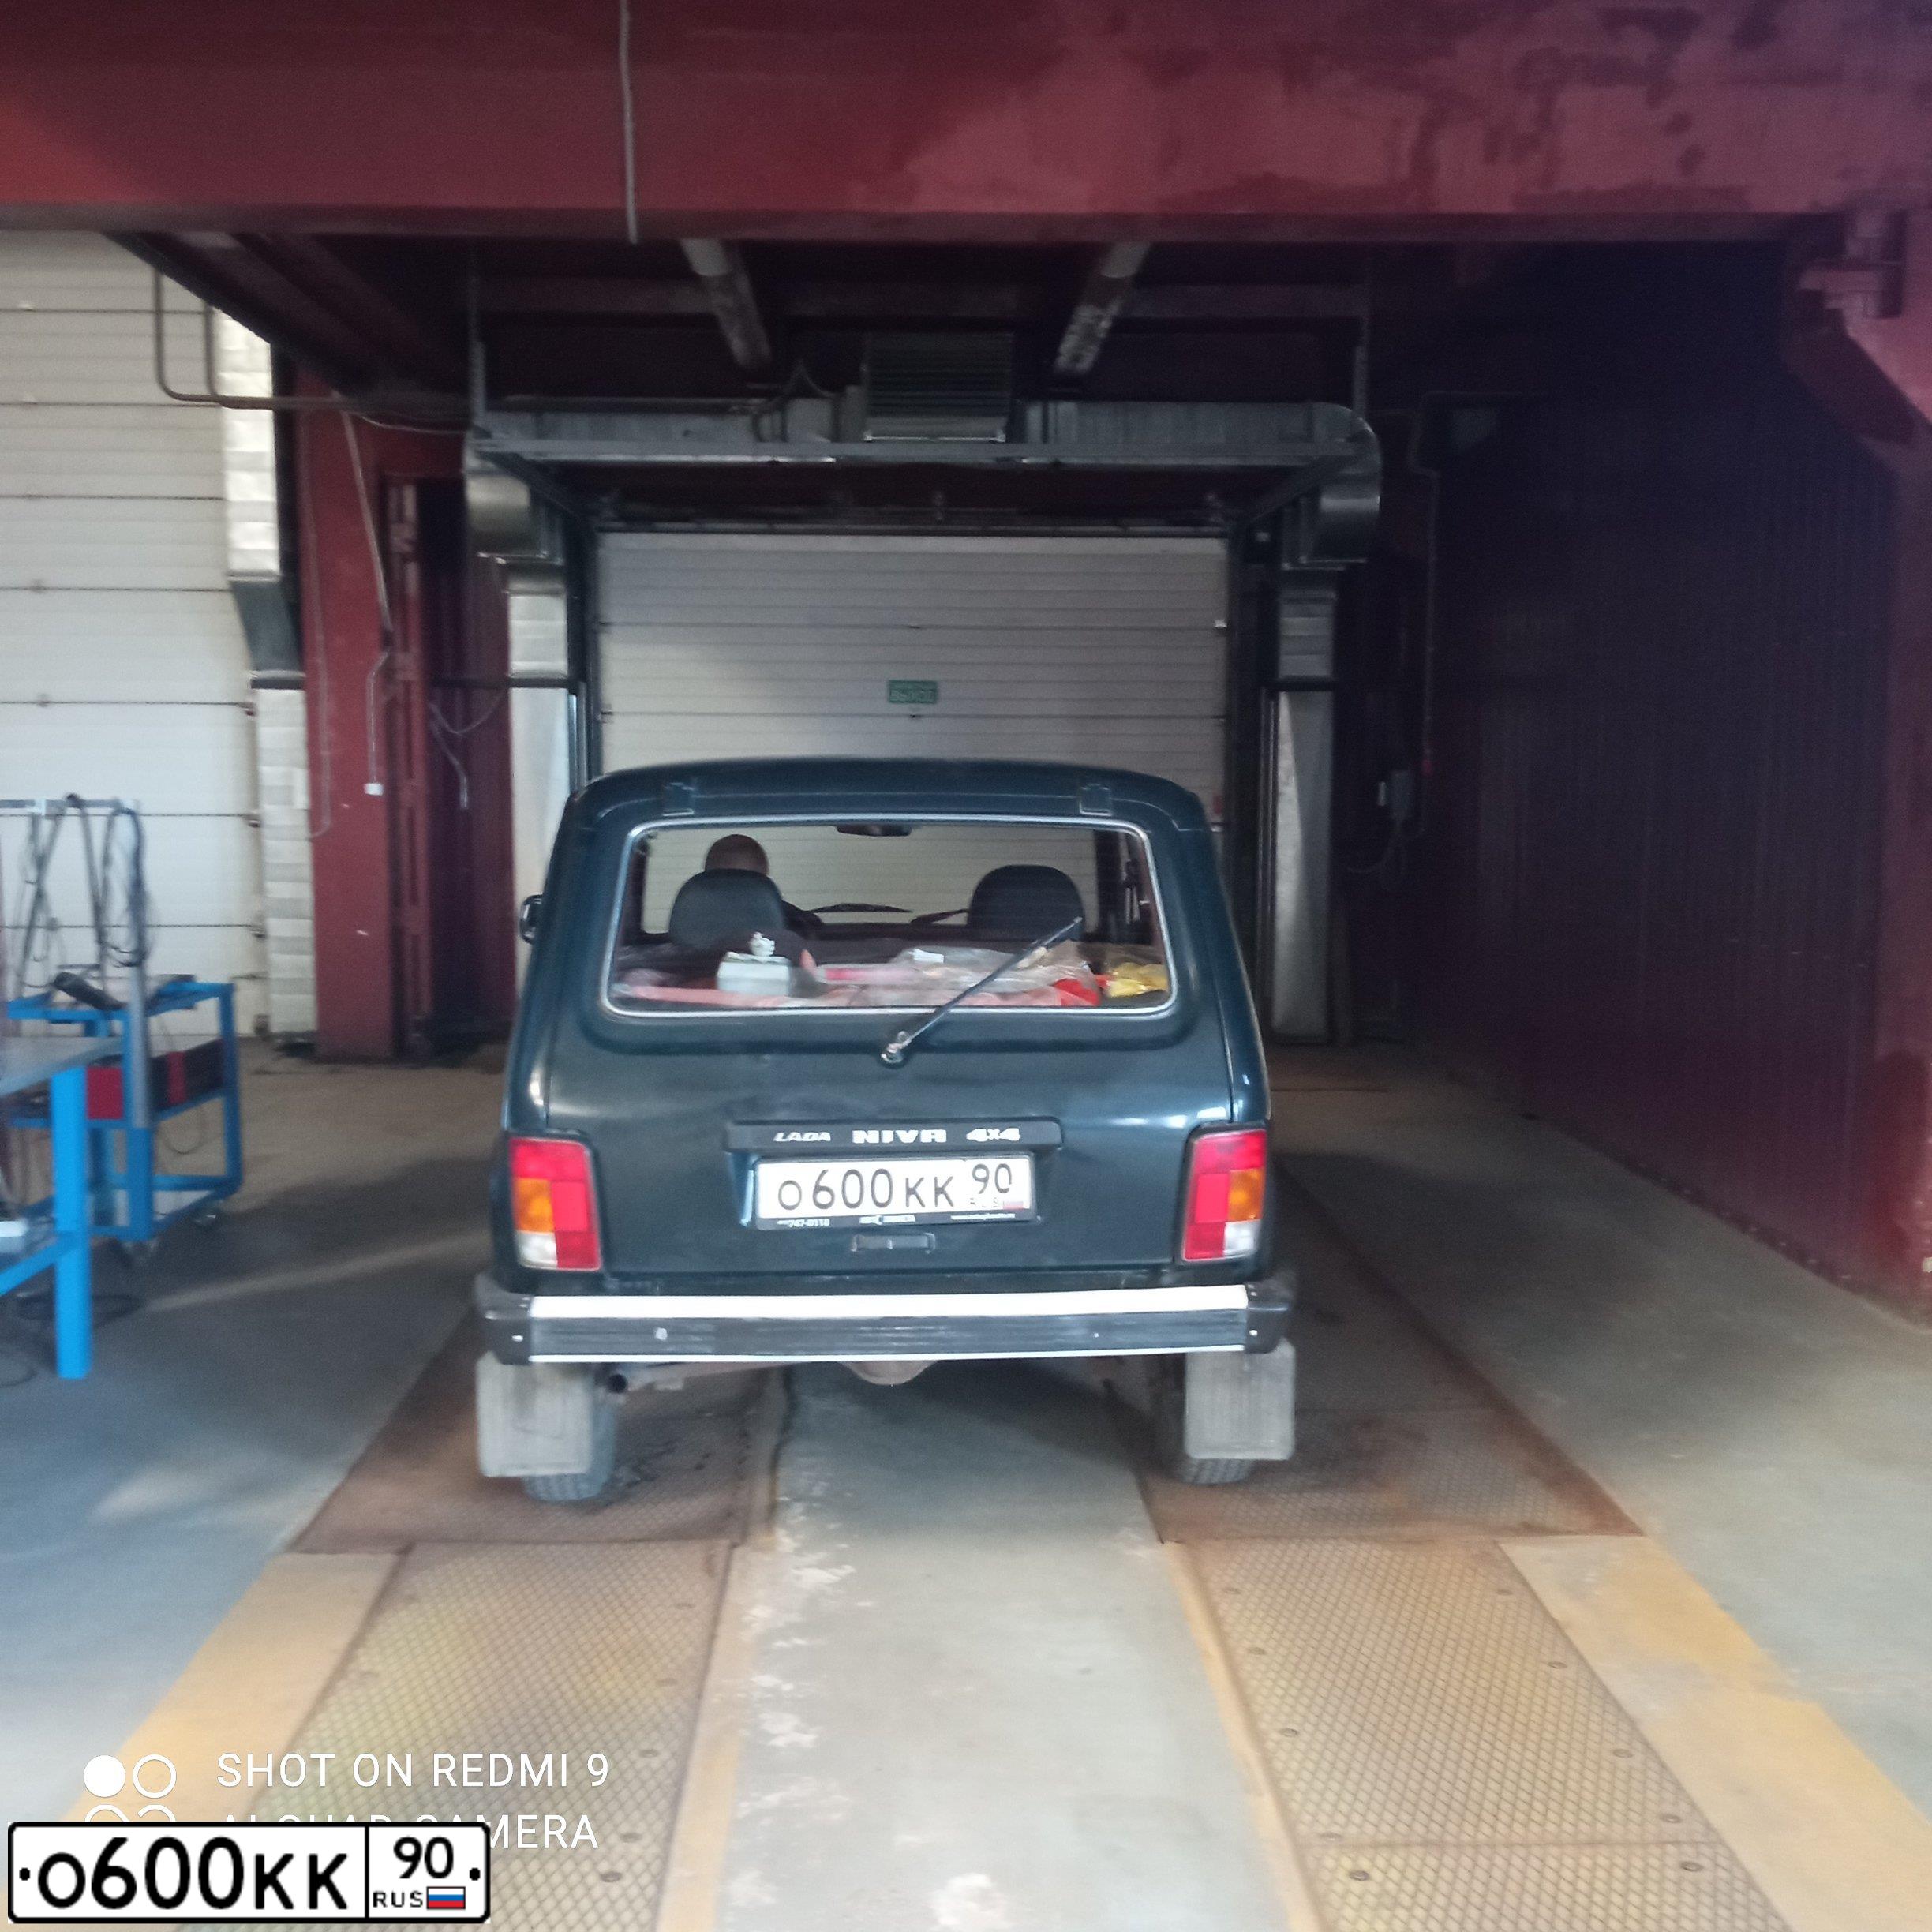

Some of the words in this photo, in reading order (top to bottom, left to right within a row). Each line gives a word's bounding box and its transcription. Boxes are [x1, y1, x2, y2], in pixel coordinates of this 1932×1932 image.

[773, 1131, 831, 1142] LADA
[852, 1129, 947, 1144] NIVA
[972, 1163, 1012, 1194] 90
